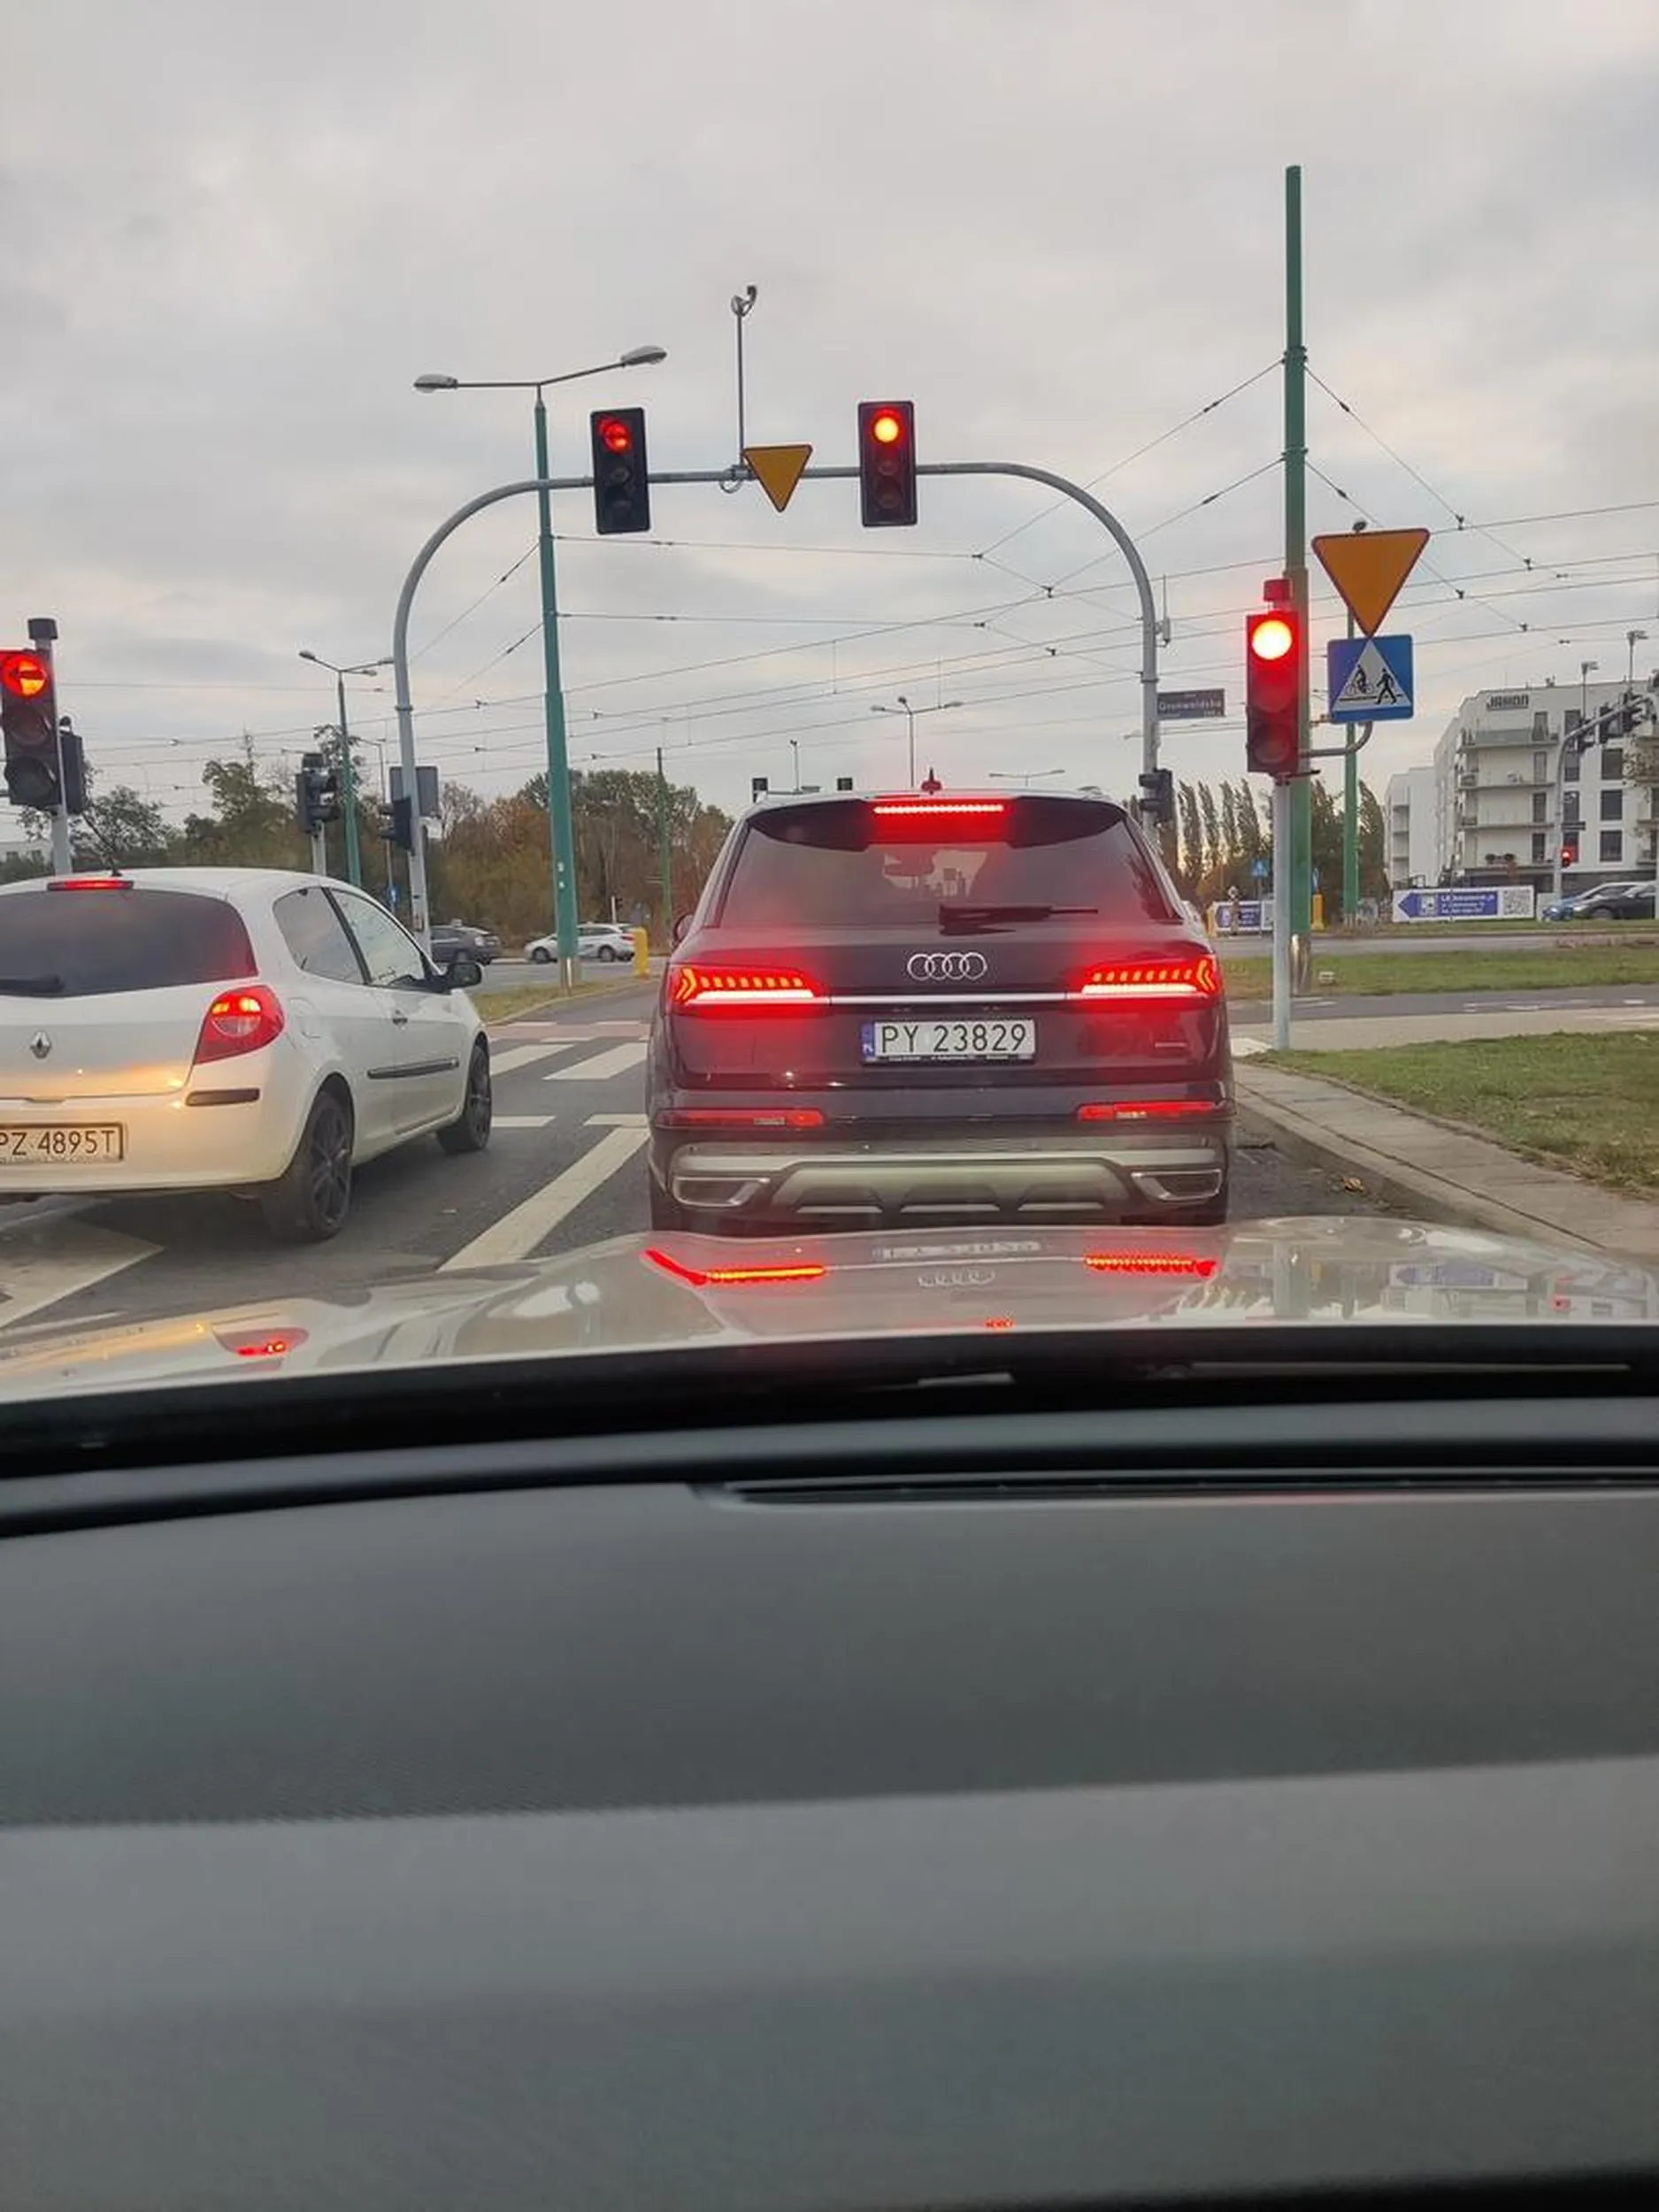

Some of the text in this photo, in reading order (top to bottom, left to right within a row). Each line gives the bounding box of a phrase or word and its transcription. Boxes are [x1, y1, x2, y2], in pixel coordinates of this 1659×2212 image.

[881, 1025, 918, 1053] PY
[933, 1024, 1027, 1051] 23829
[0, 1130, 116, 1156] PZ 4895T
